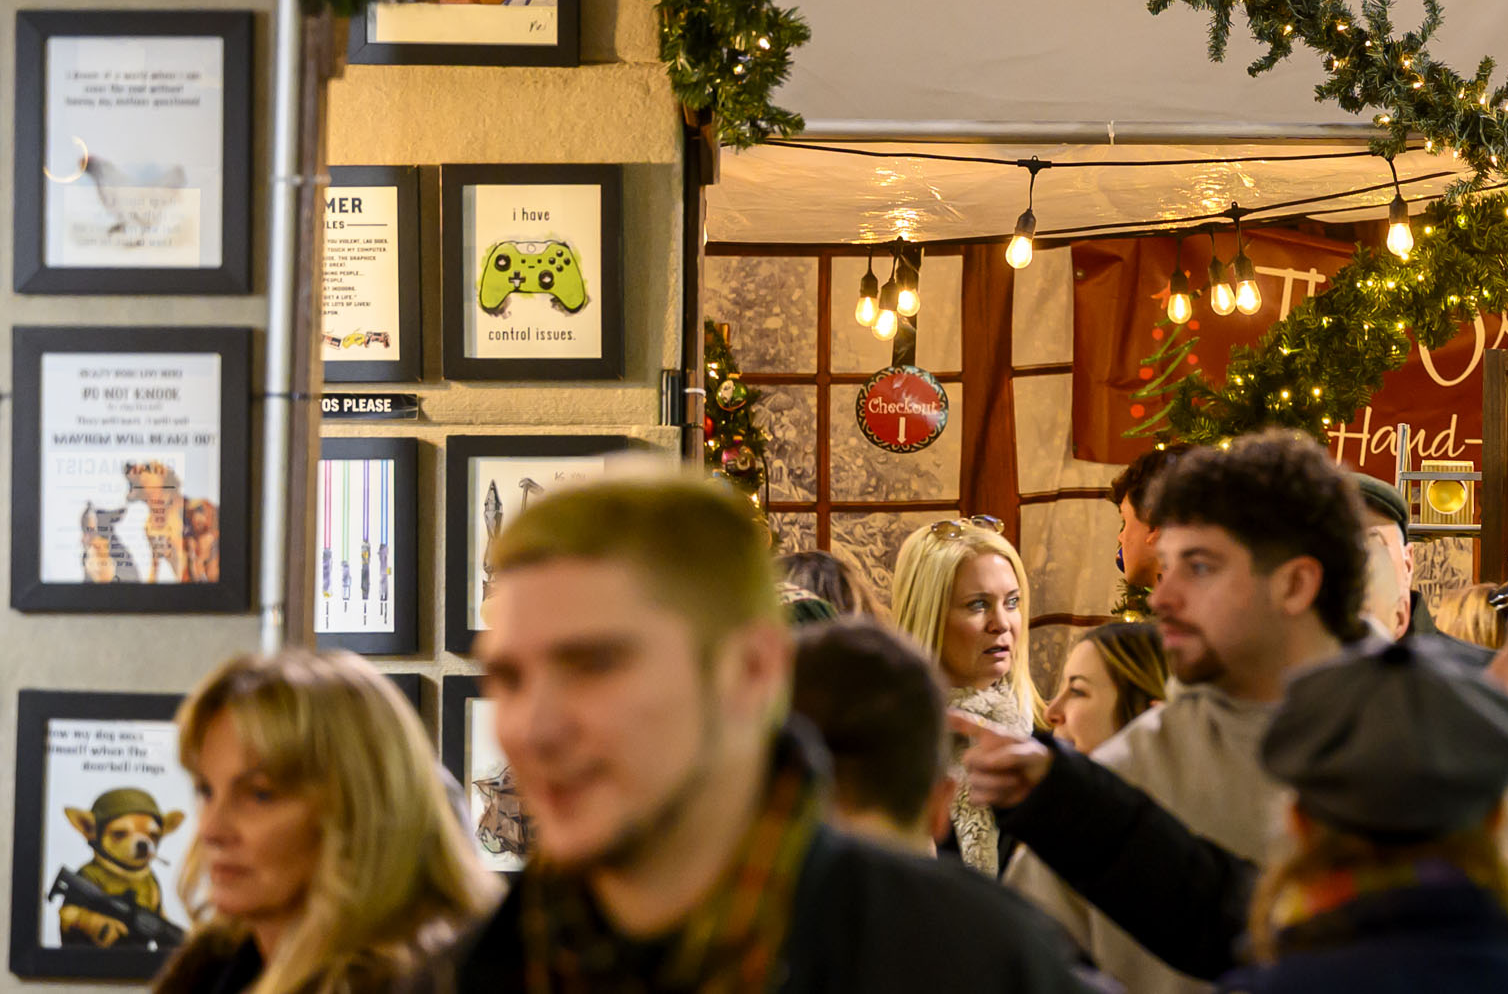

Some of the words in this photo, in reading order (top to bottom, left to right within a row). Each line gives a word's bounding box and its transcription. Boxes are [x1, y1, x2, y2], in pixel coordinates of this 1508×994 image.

[513, 208, 517, 221] i
[521, 207, 550, 221] have
[488, 327, 531, 341] control
[536, 327, 577, 341] issues.
[343, 398, 392, 412] PLEASE
[868, 396, 937, 415] Checkout
